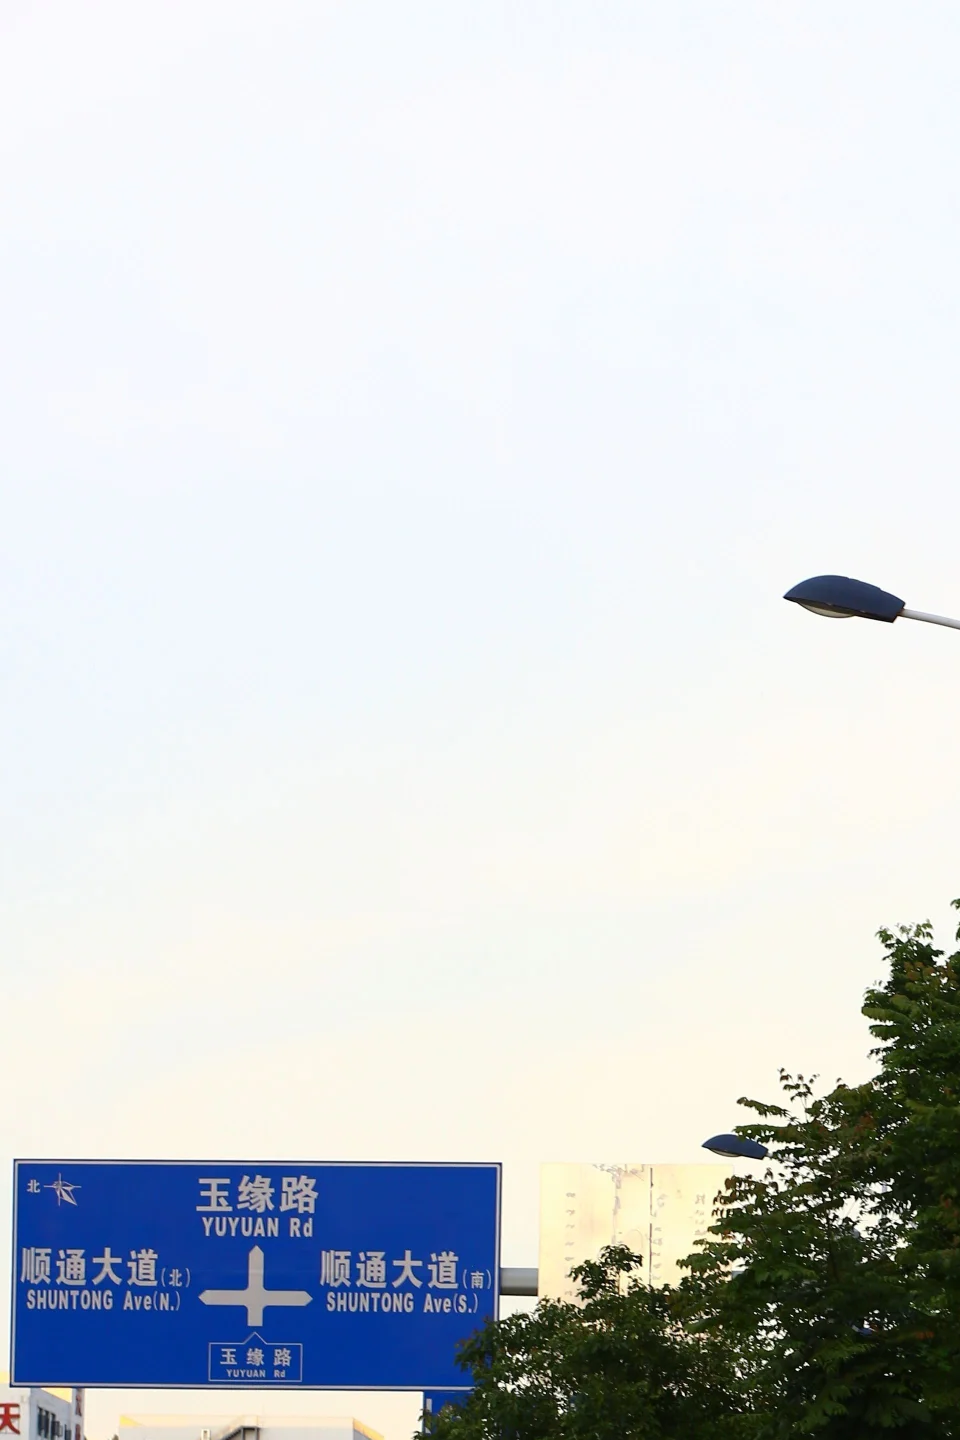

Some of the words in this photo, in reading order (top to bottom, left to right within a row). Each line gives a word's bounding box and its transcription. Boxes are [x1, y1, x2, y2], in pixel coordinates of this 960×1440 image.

[27, 1179, 41, 1193] 北
[196, 1175, 319, 1213] 玉缘路
[202, 1217, 279, 1237] YUYUAN
[289, 1217, 313, 1237] Rd
[26, 1289, 113, 1310] SHUNTONG
[326, 1291, 414, 1312] SHUNTONG
[220, 1348, 292, 1366] 玉缘路
[226, 1369, 266, 1378] YUYUAN
[274, 1369, 286, 1378] Rd
